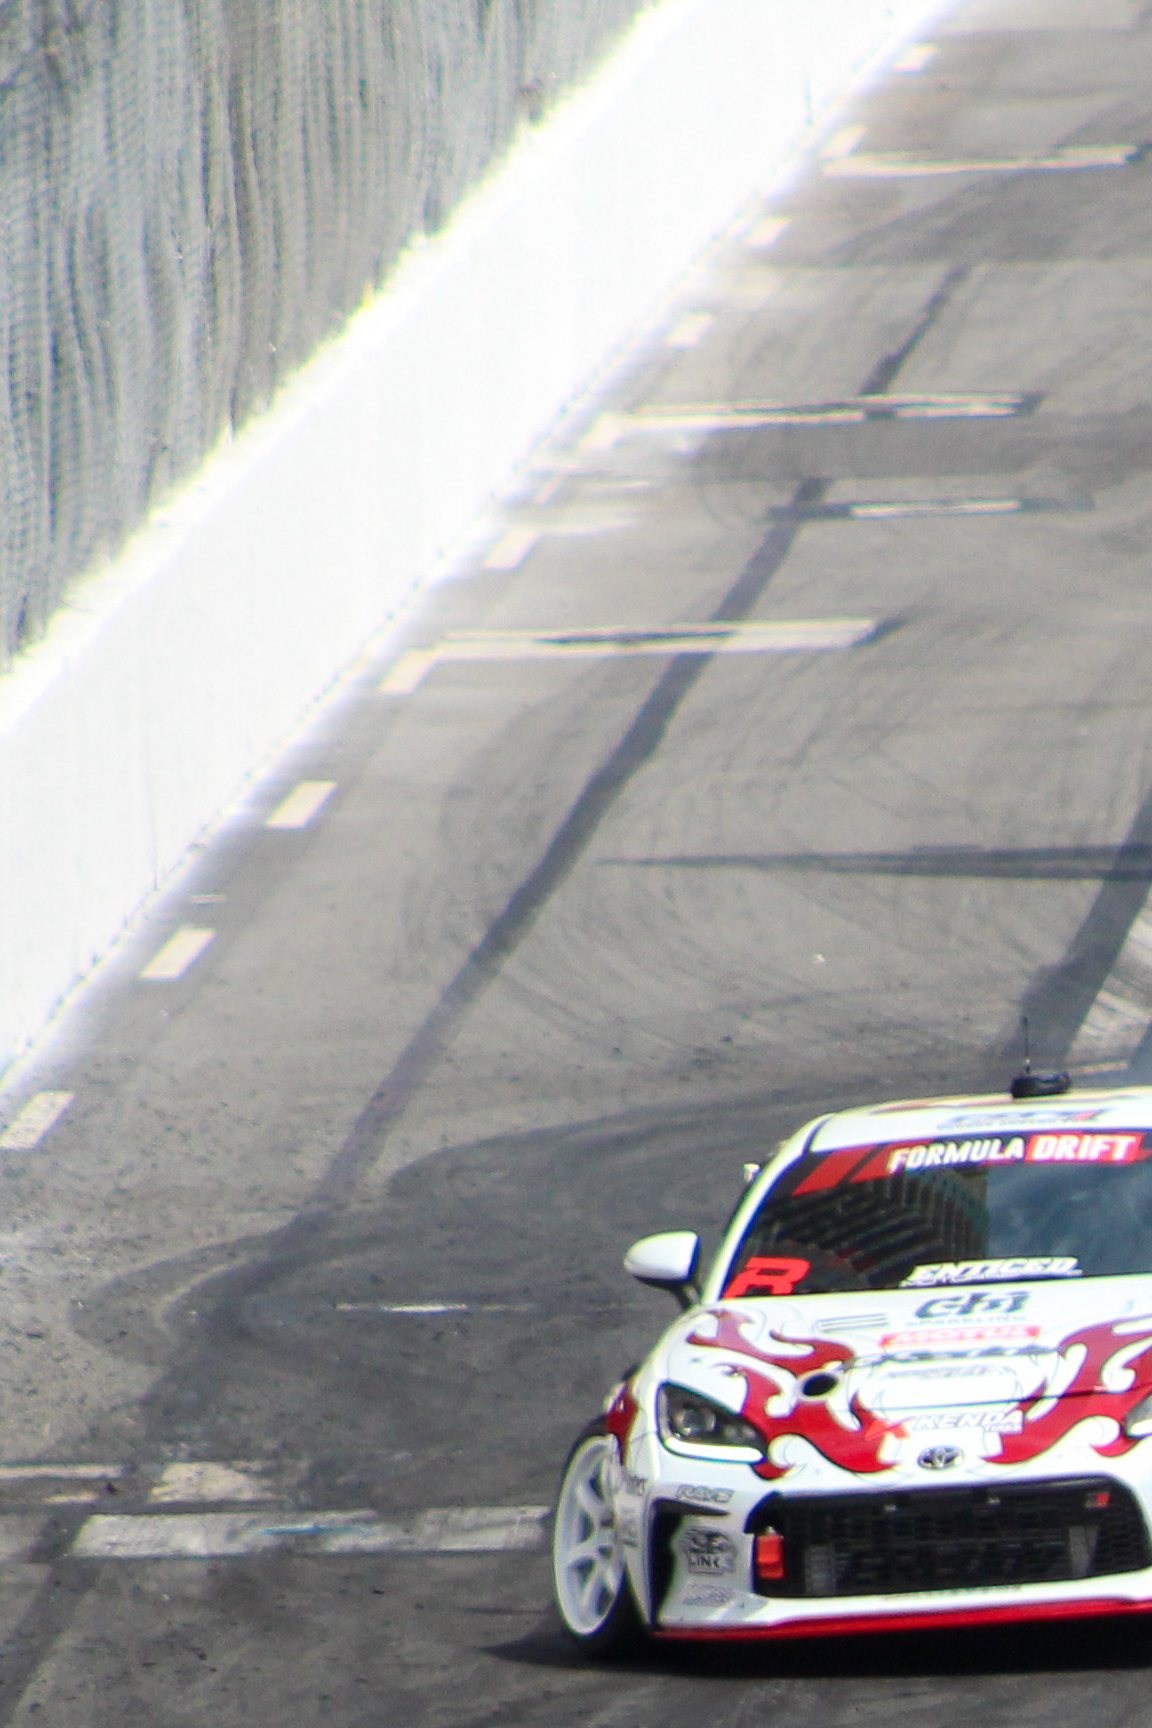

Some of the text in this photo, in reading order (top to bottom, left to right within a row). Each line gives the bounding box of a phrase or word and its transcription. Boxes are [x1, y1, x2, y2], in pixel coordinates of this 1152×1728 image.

[886, 1134, 1137, 1171] FORMULA DRIFT
[913, 1410, 1023, 1430] KENDA
